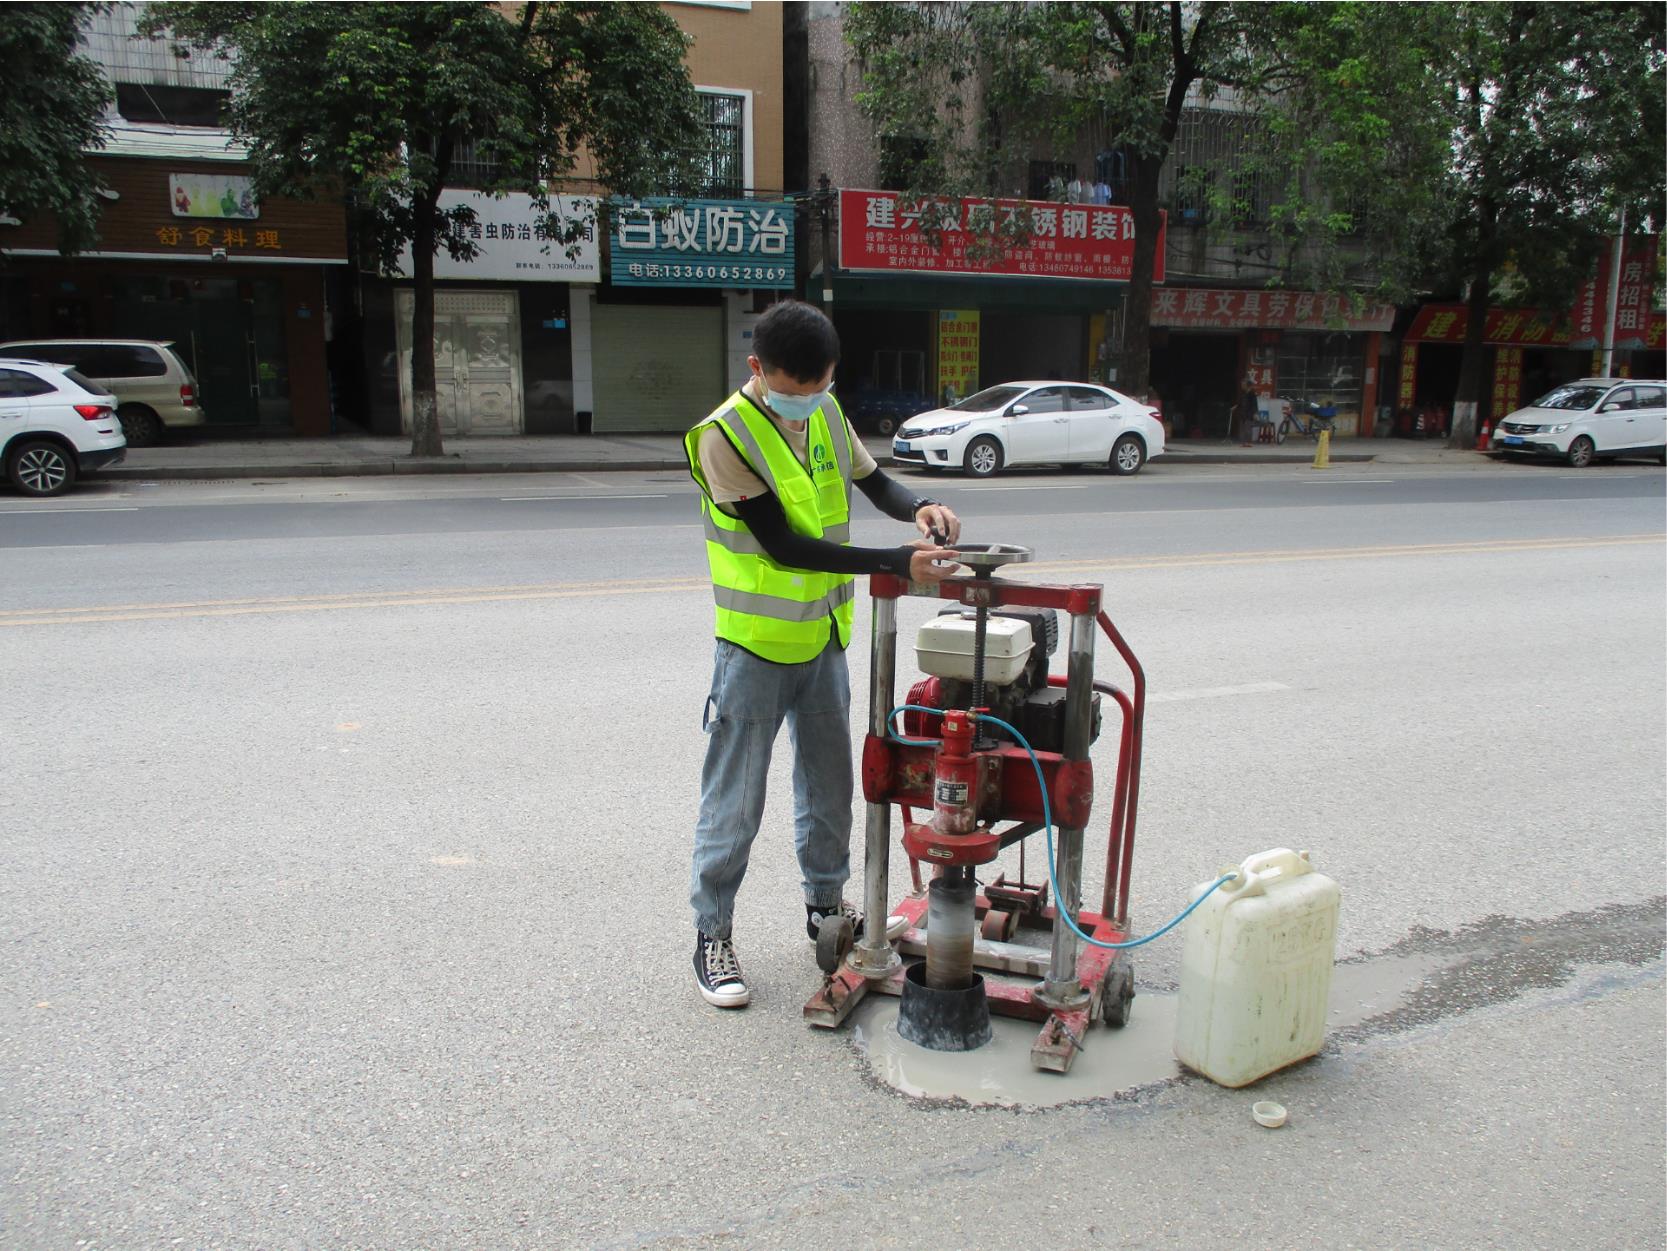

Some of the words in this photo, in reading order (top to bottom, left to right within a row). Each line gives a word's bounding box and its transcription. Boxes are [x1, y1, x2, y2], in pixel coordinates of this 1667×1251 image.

[156, 226, 282, 250] 舒食料理
[618, 202, 788, 254] 白蚁防治
[628, 263, 785, 281] 电话:13360652869
